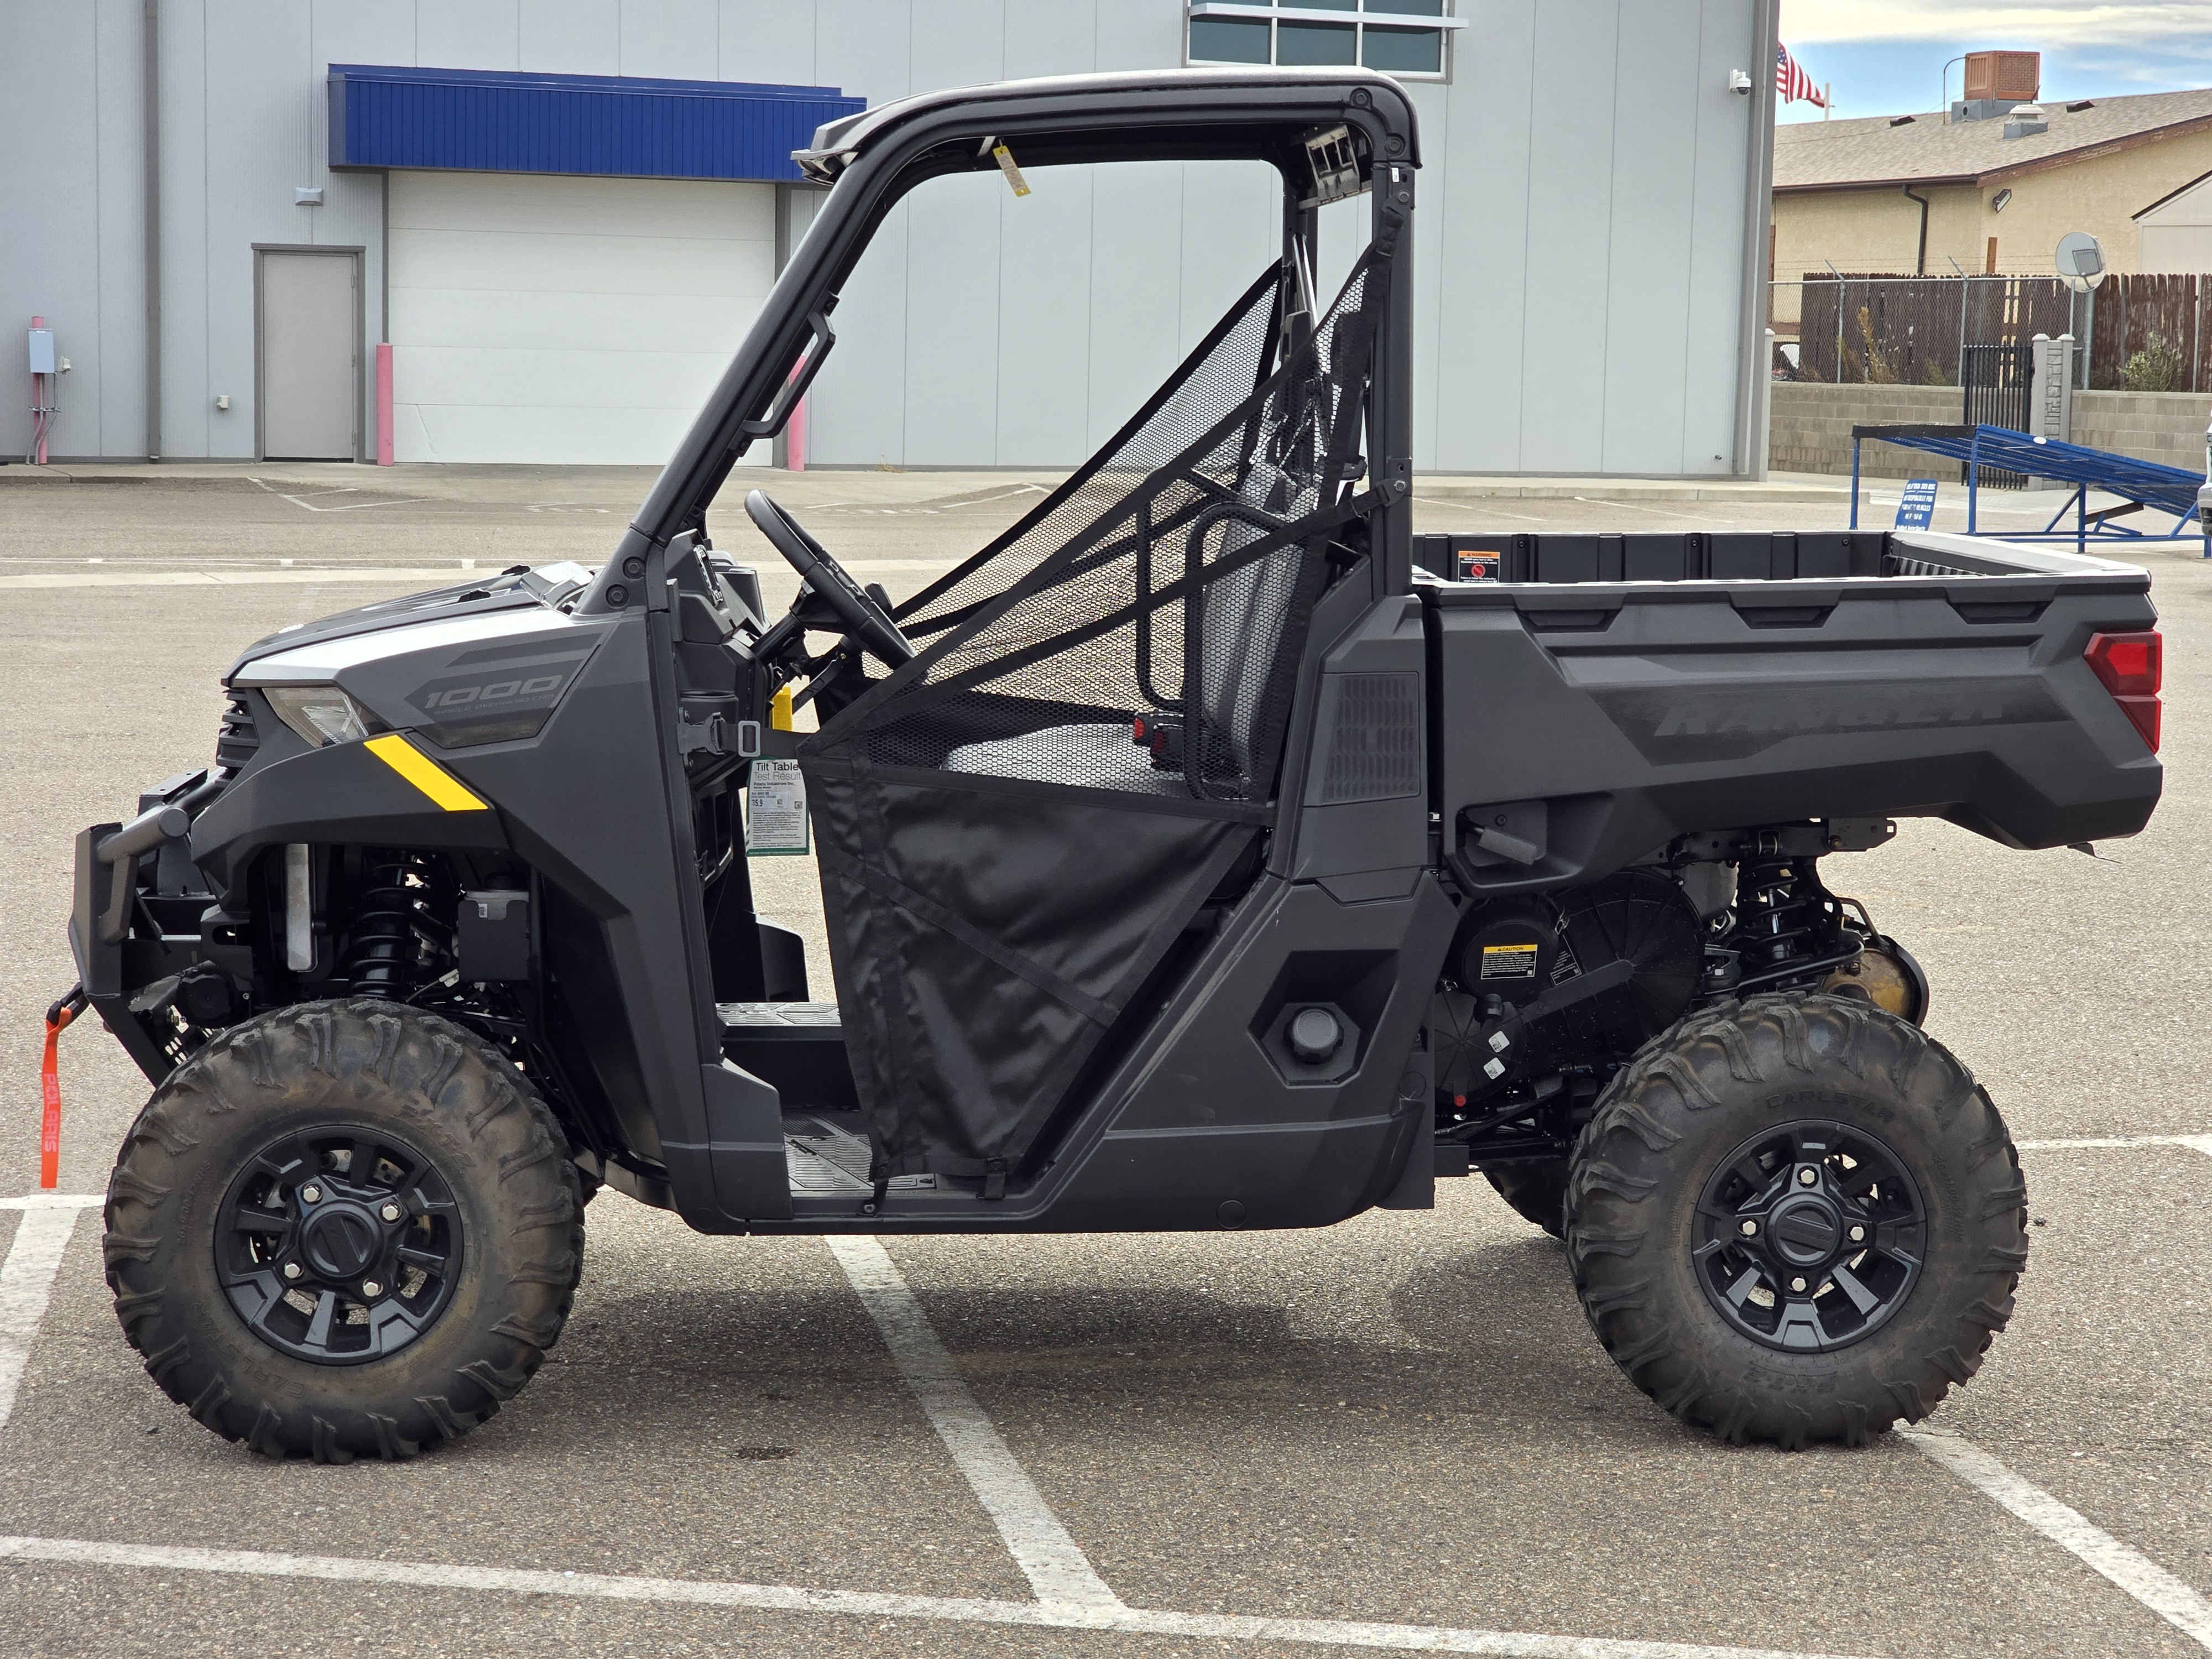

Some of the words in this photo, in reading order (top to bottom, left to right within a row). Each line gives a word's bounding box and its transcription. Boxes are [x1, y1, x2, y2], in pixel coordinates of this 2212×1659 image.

[424, 675, 563, 708] 1000
[434, 706, 472, 715] SINGLE
[475, 697, 530, 709] OVERHEAD
[756, 763, 769, 771] Tilt
[773, 762, 799, 771] Table
[754, 772, 770, 781] Test
[773, 771, 801, 780] Result
[752, 799, 763, 807] 35.9
[44, 1073, 59, 1152] POLARIS
[1766, 1090, 1896, 1122] CARLSTAR
